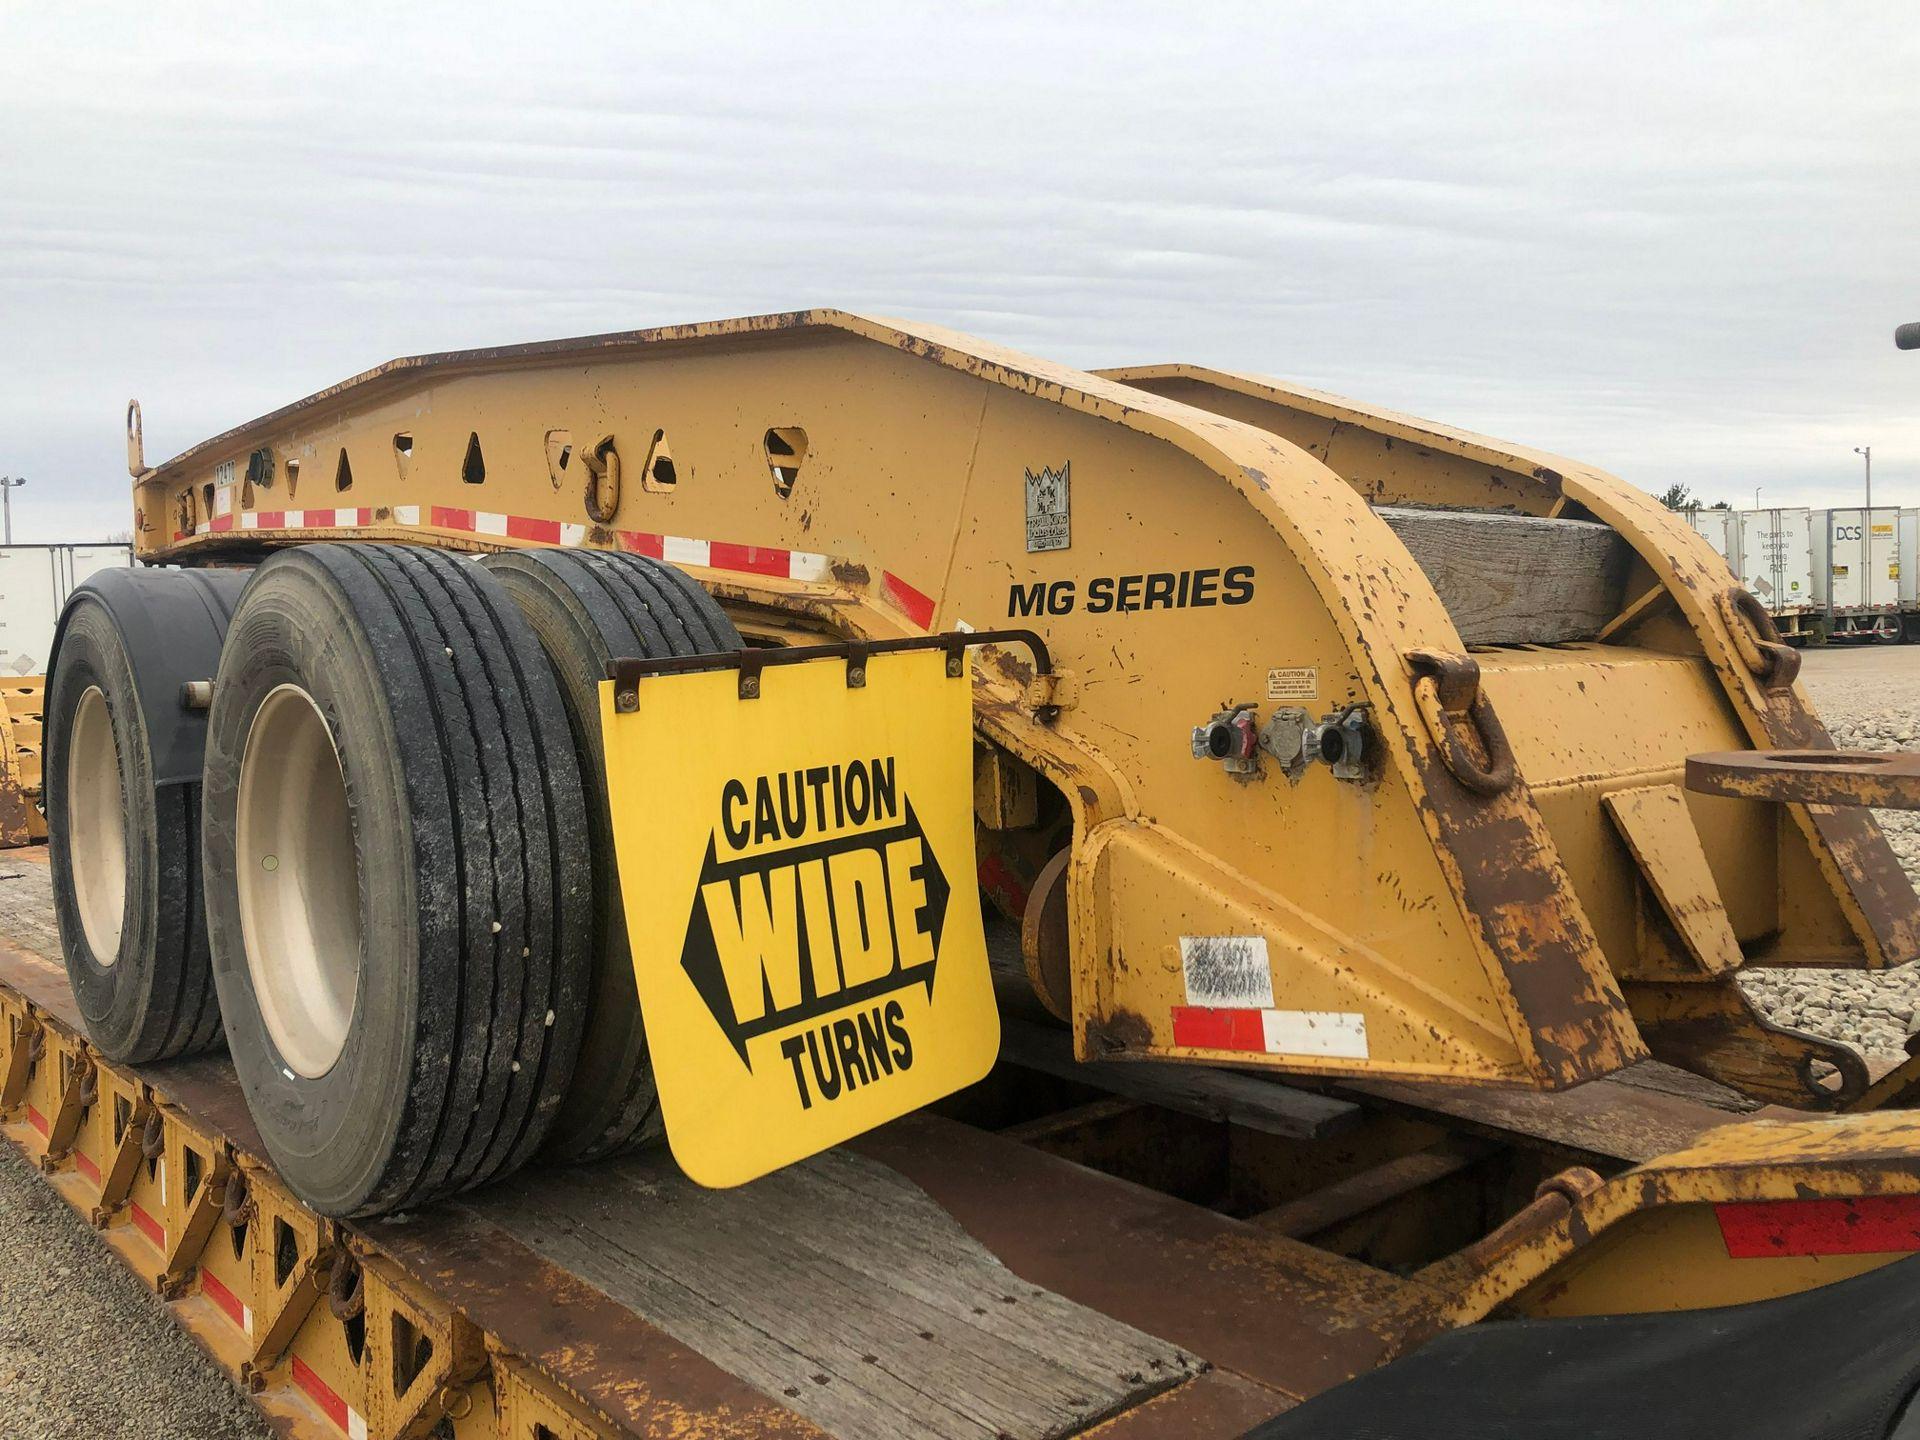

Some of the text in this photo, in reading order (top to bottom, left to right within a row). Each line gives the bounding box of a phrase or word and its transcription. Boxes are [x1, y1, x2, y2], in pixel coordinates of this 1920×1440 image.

[1757, 530, 1768, 539] The
[1786, 530, 1793, 538] to
[1836, 526, 1862, 541] DCS
[1007, 565, 1255, 618] MG SERIES
[1277, 670, 1305, 678] CAUTION
[721, 756, 897, 851] CAUTION
[701, 837, 935, 1026] WIDE
[781, 1000, 914, 1111] TURNS
